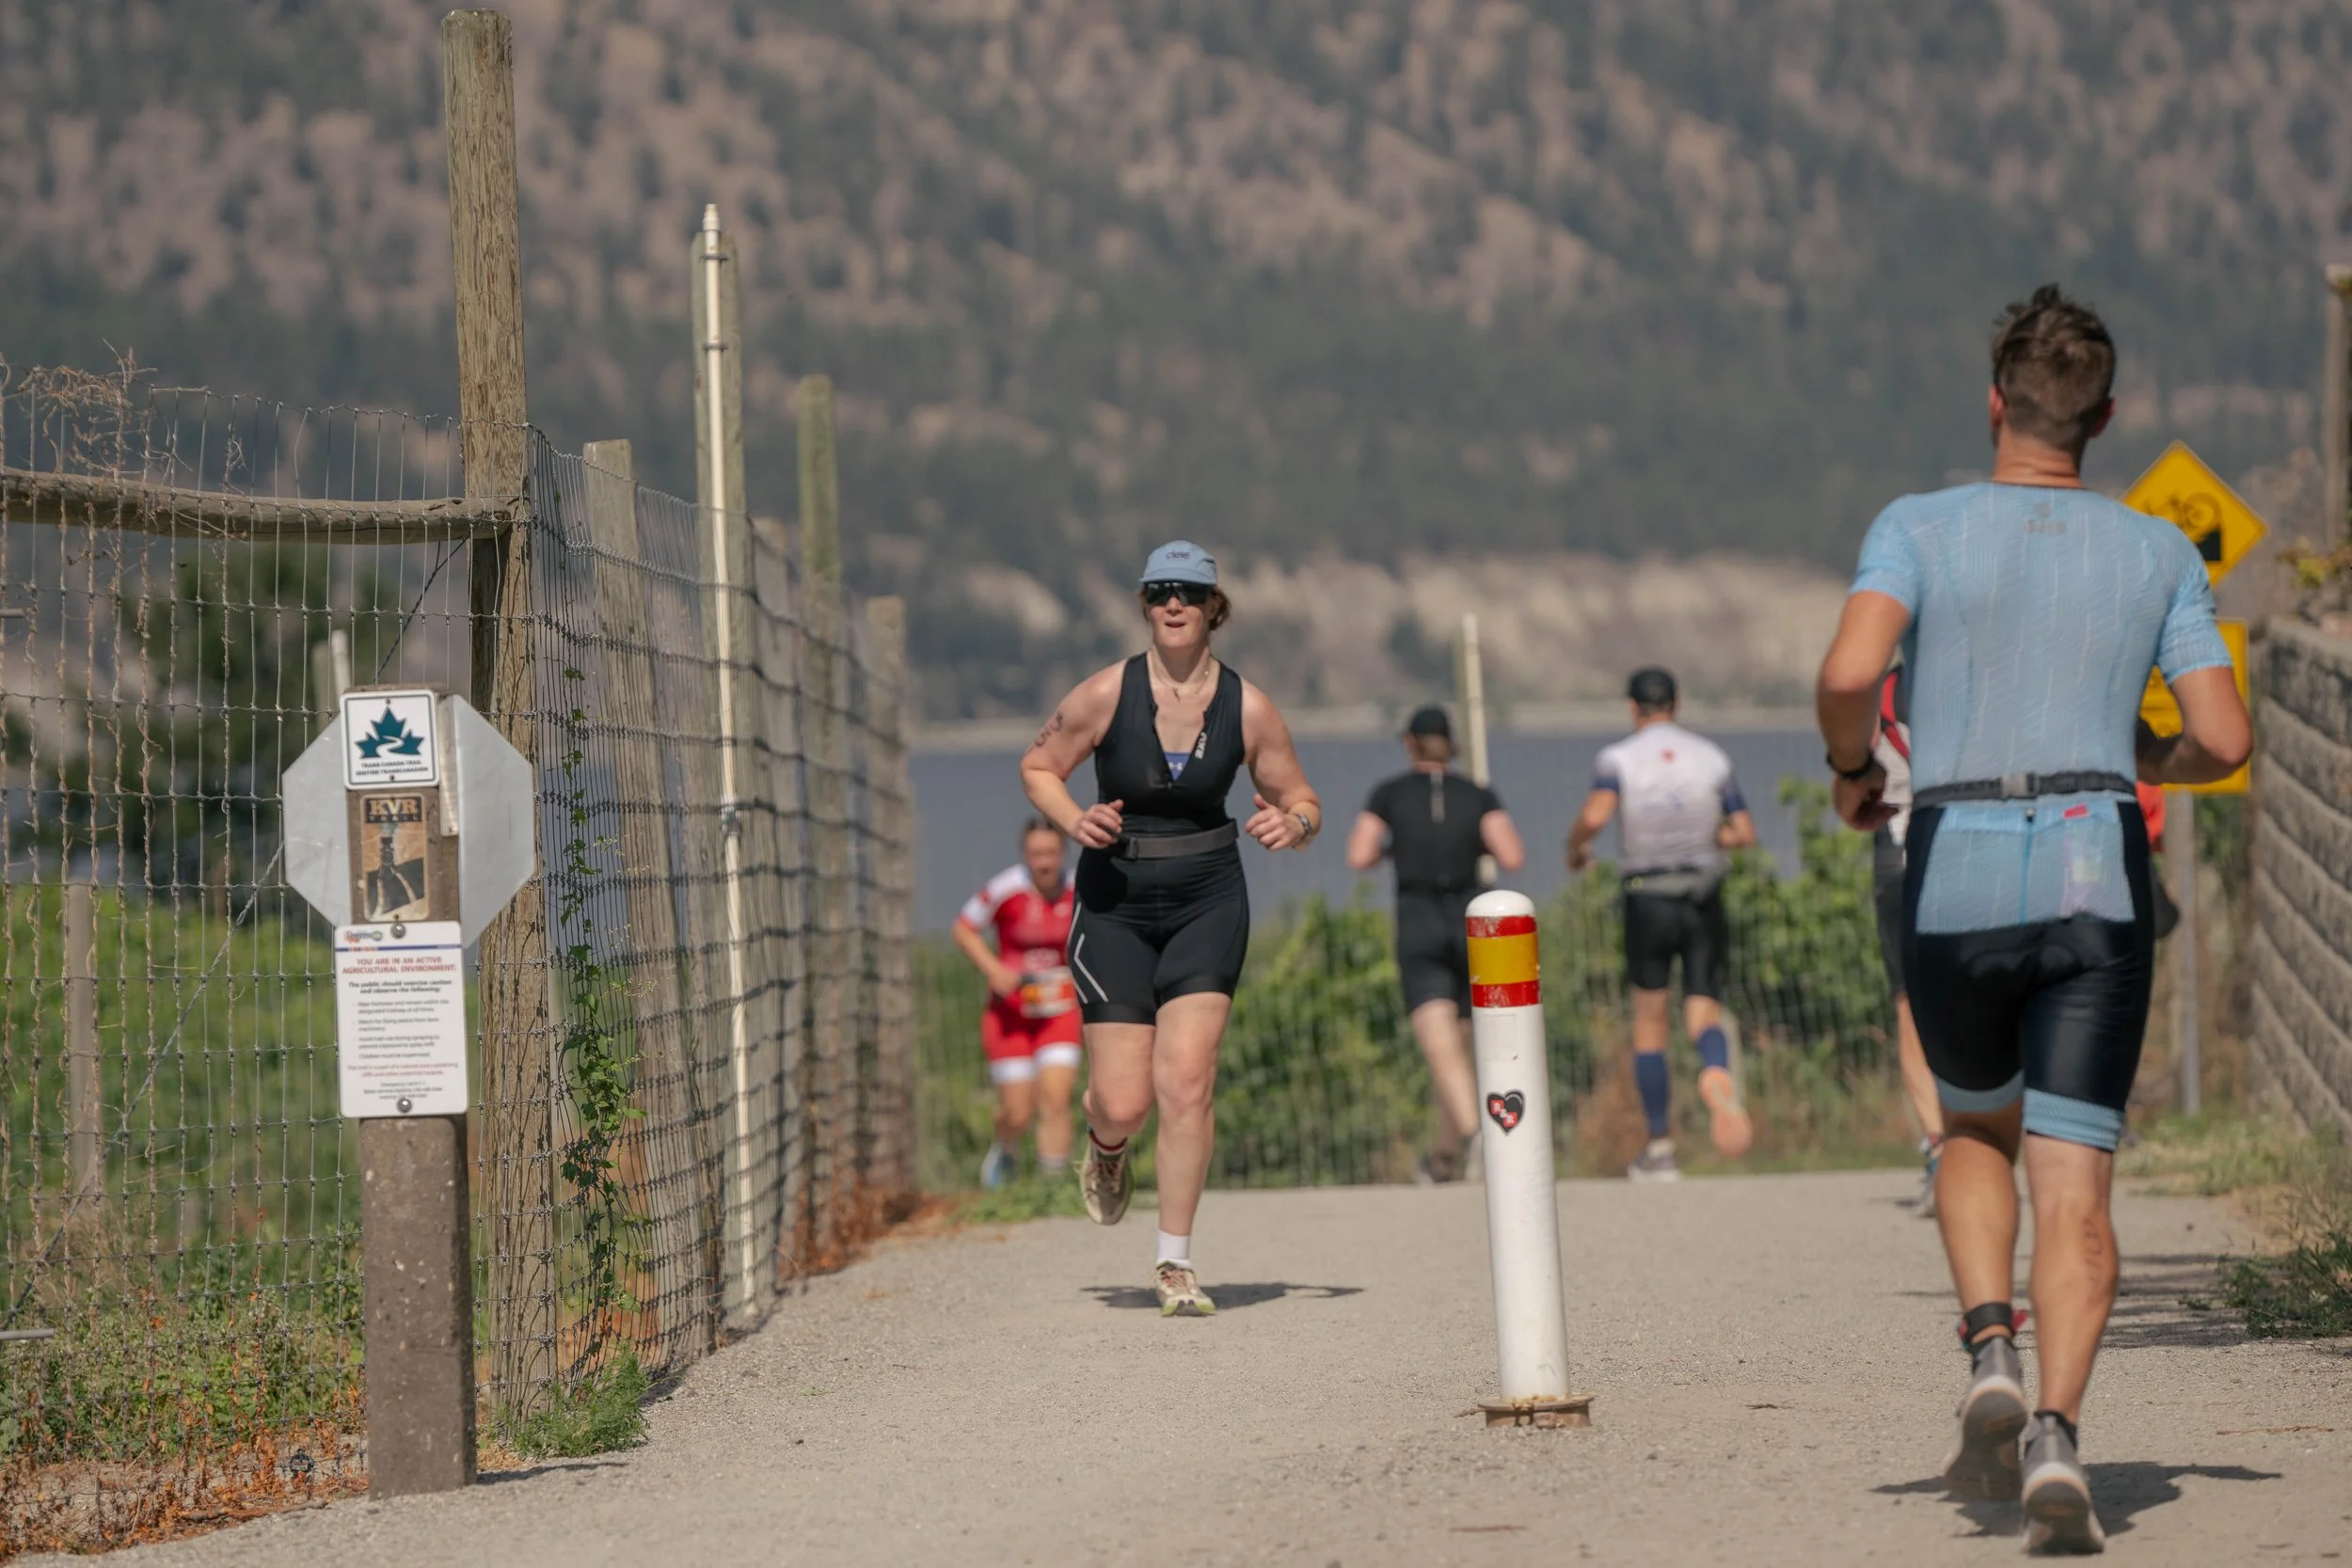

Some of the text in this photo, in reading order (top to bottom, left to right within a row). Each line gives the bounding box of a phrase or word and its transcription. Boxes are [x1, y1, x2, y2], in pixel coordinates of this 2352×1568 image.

[369, 800, 418, 816] KVR
[342, 964, 456, 974] AGRICULTURAL ENVIRONMENT.
